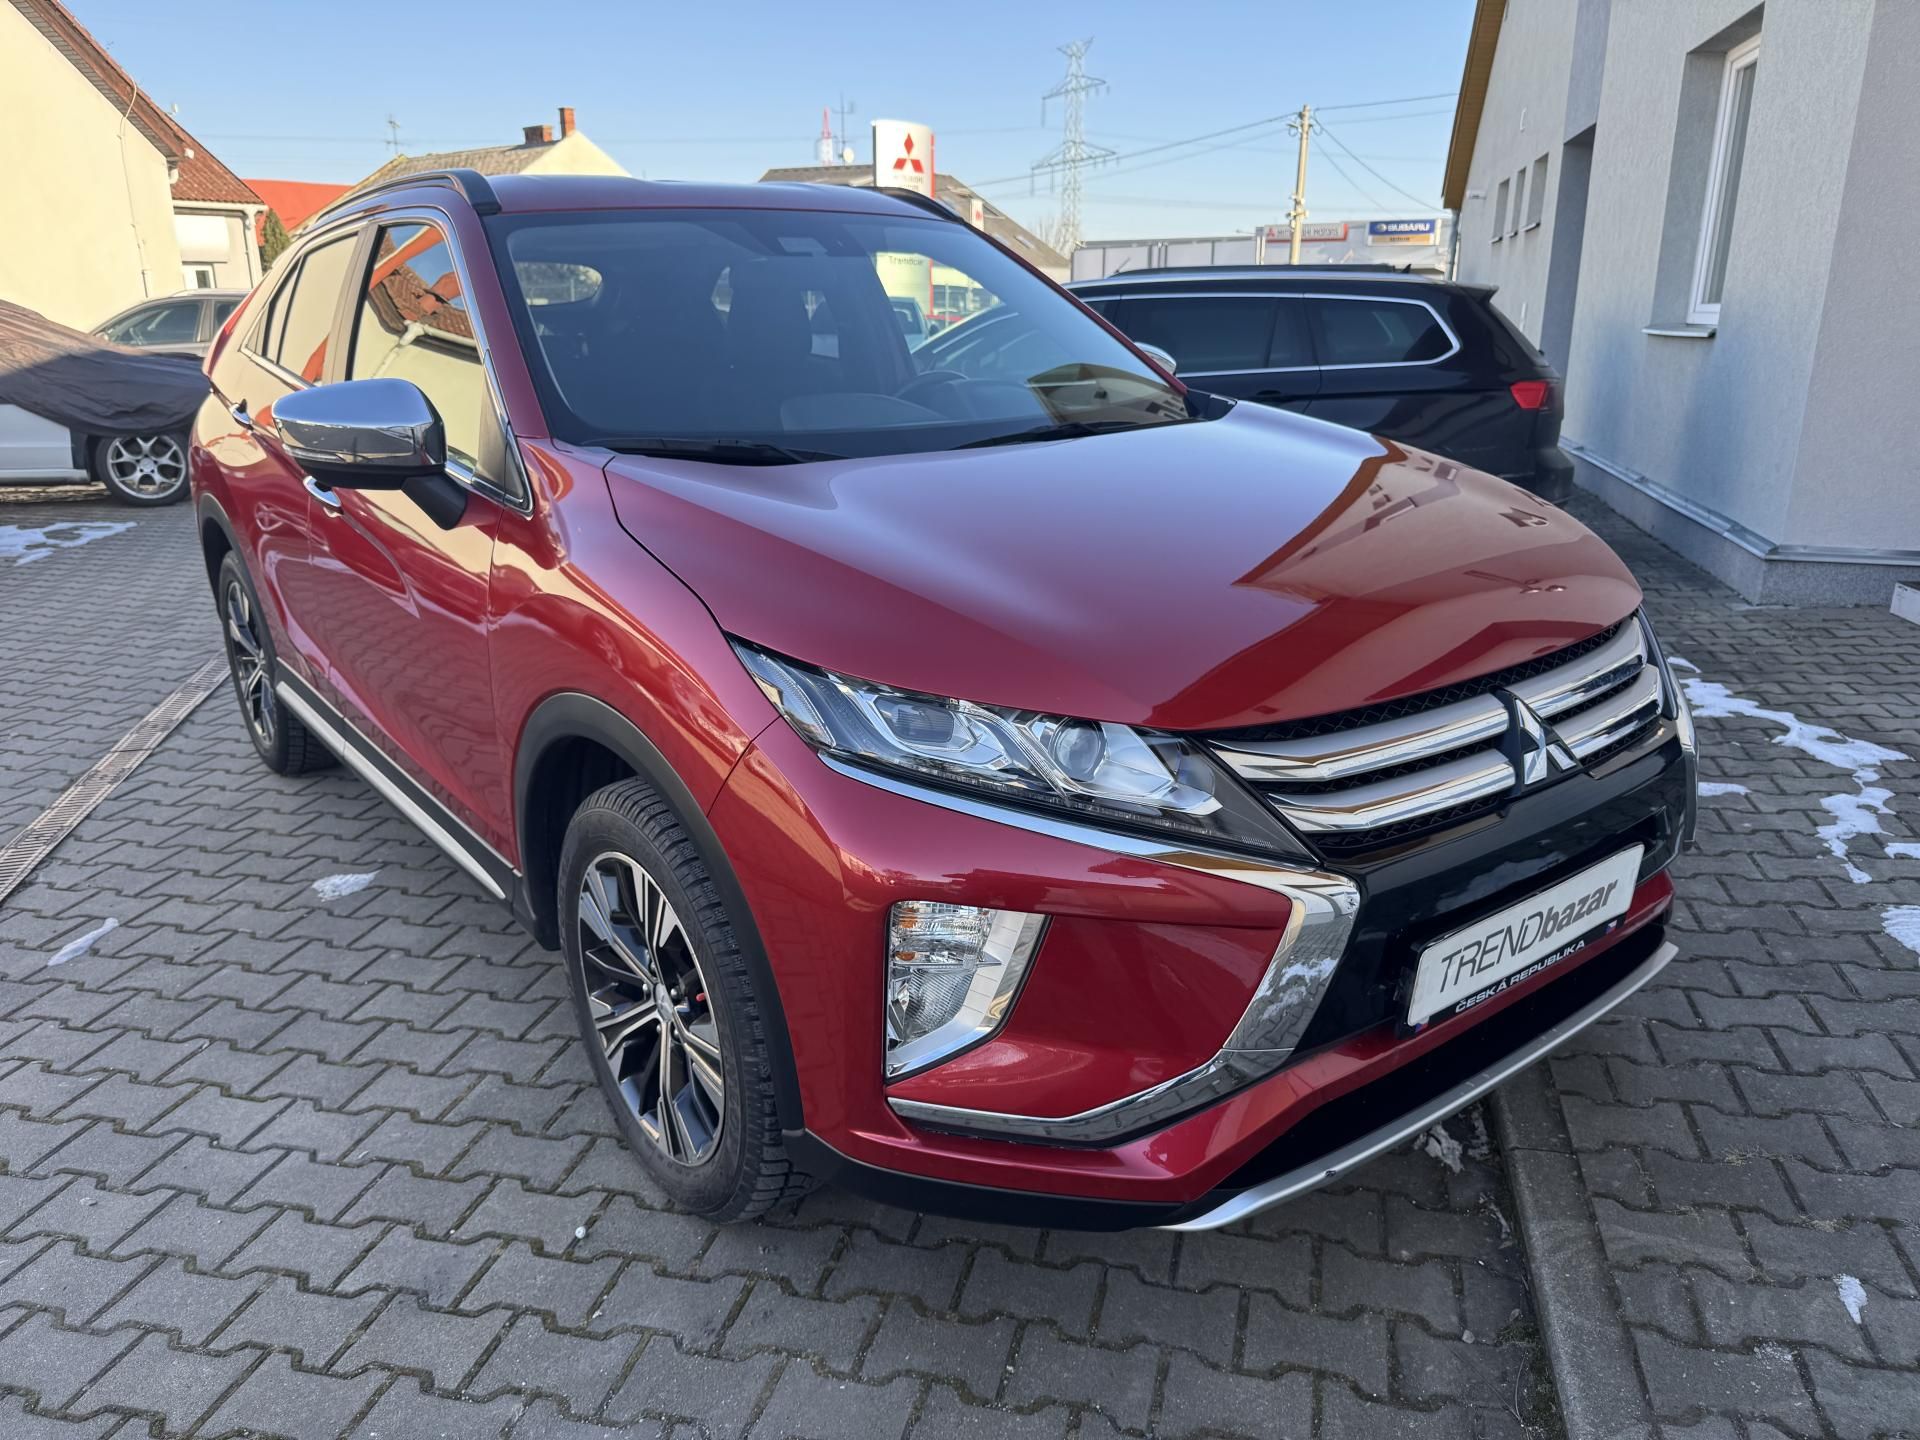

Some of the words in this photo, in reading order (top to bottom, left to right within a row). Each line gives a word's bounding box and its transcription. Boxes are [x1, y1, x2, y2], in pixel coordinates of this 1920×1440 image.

[1387, 223, 1431, 232] SUBARU
[1439, 879, 1618, 993] TRENDbazar
[1455, 976, 1508, 1014] ČESKÁ
[1509, 939, 1586, 986] REPUBLIKA
